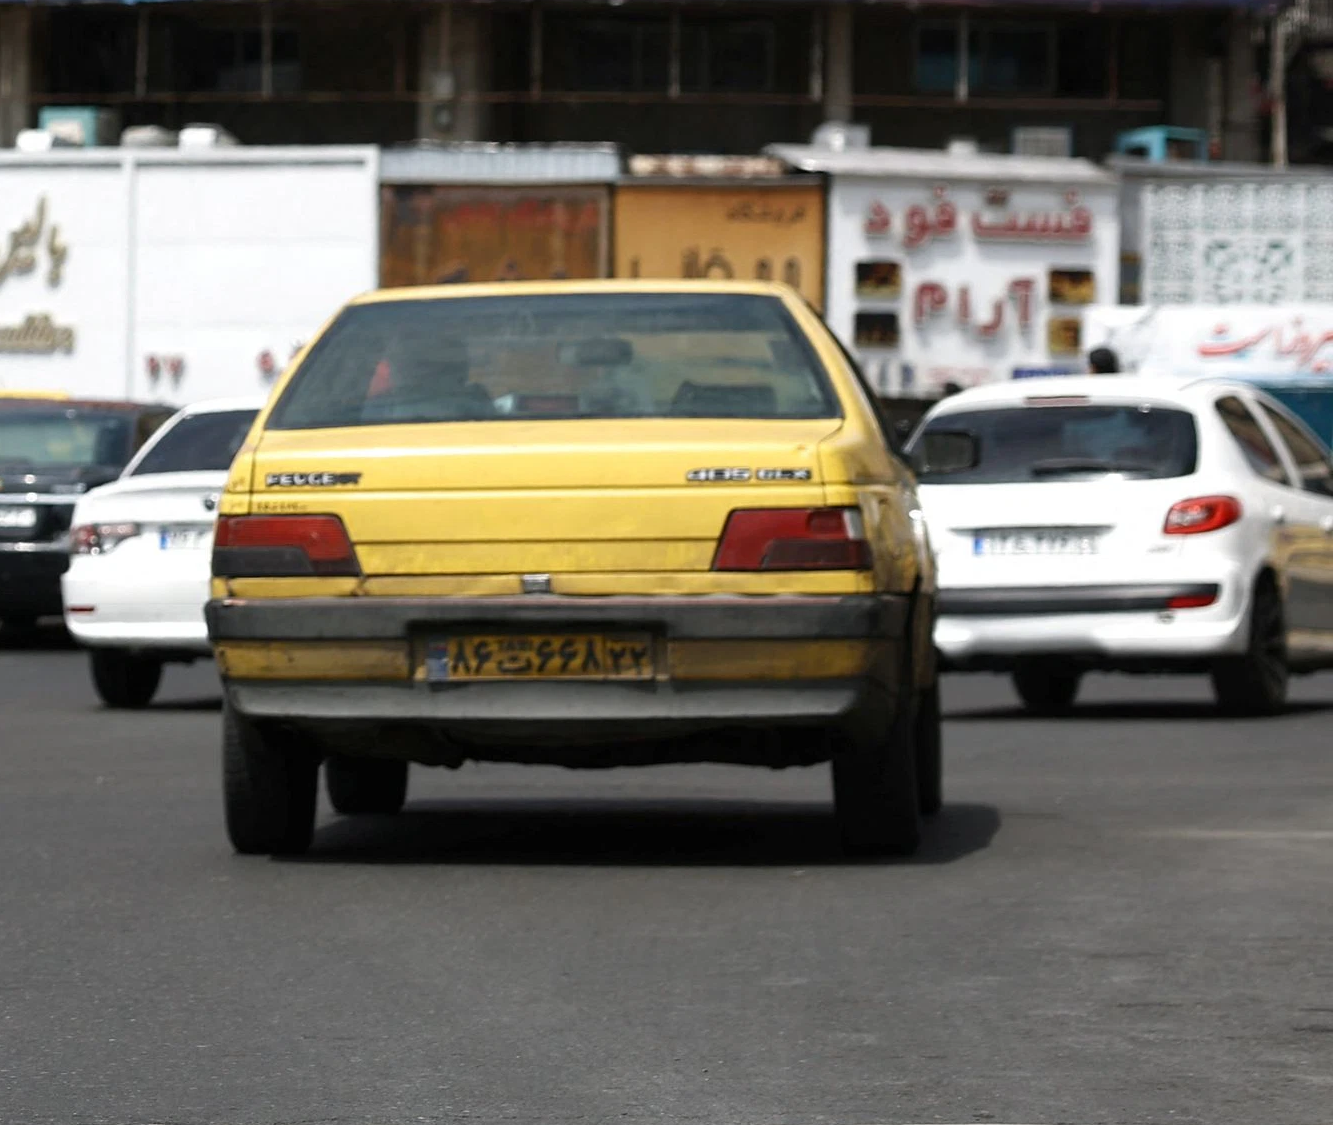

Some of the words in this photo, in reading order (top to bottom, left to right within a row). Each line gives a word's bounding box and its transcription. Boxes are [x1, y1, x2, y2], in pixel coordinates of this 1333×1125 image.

[863, 182, 958, 249] فود
[970, 186, 1094, 242] فست
[914, 276, 1036, 336] آرام
